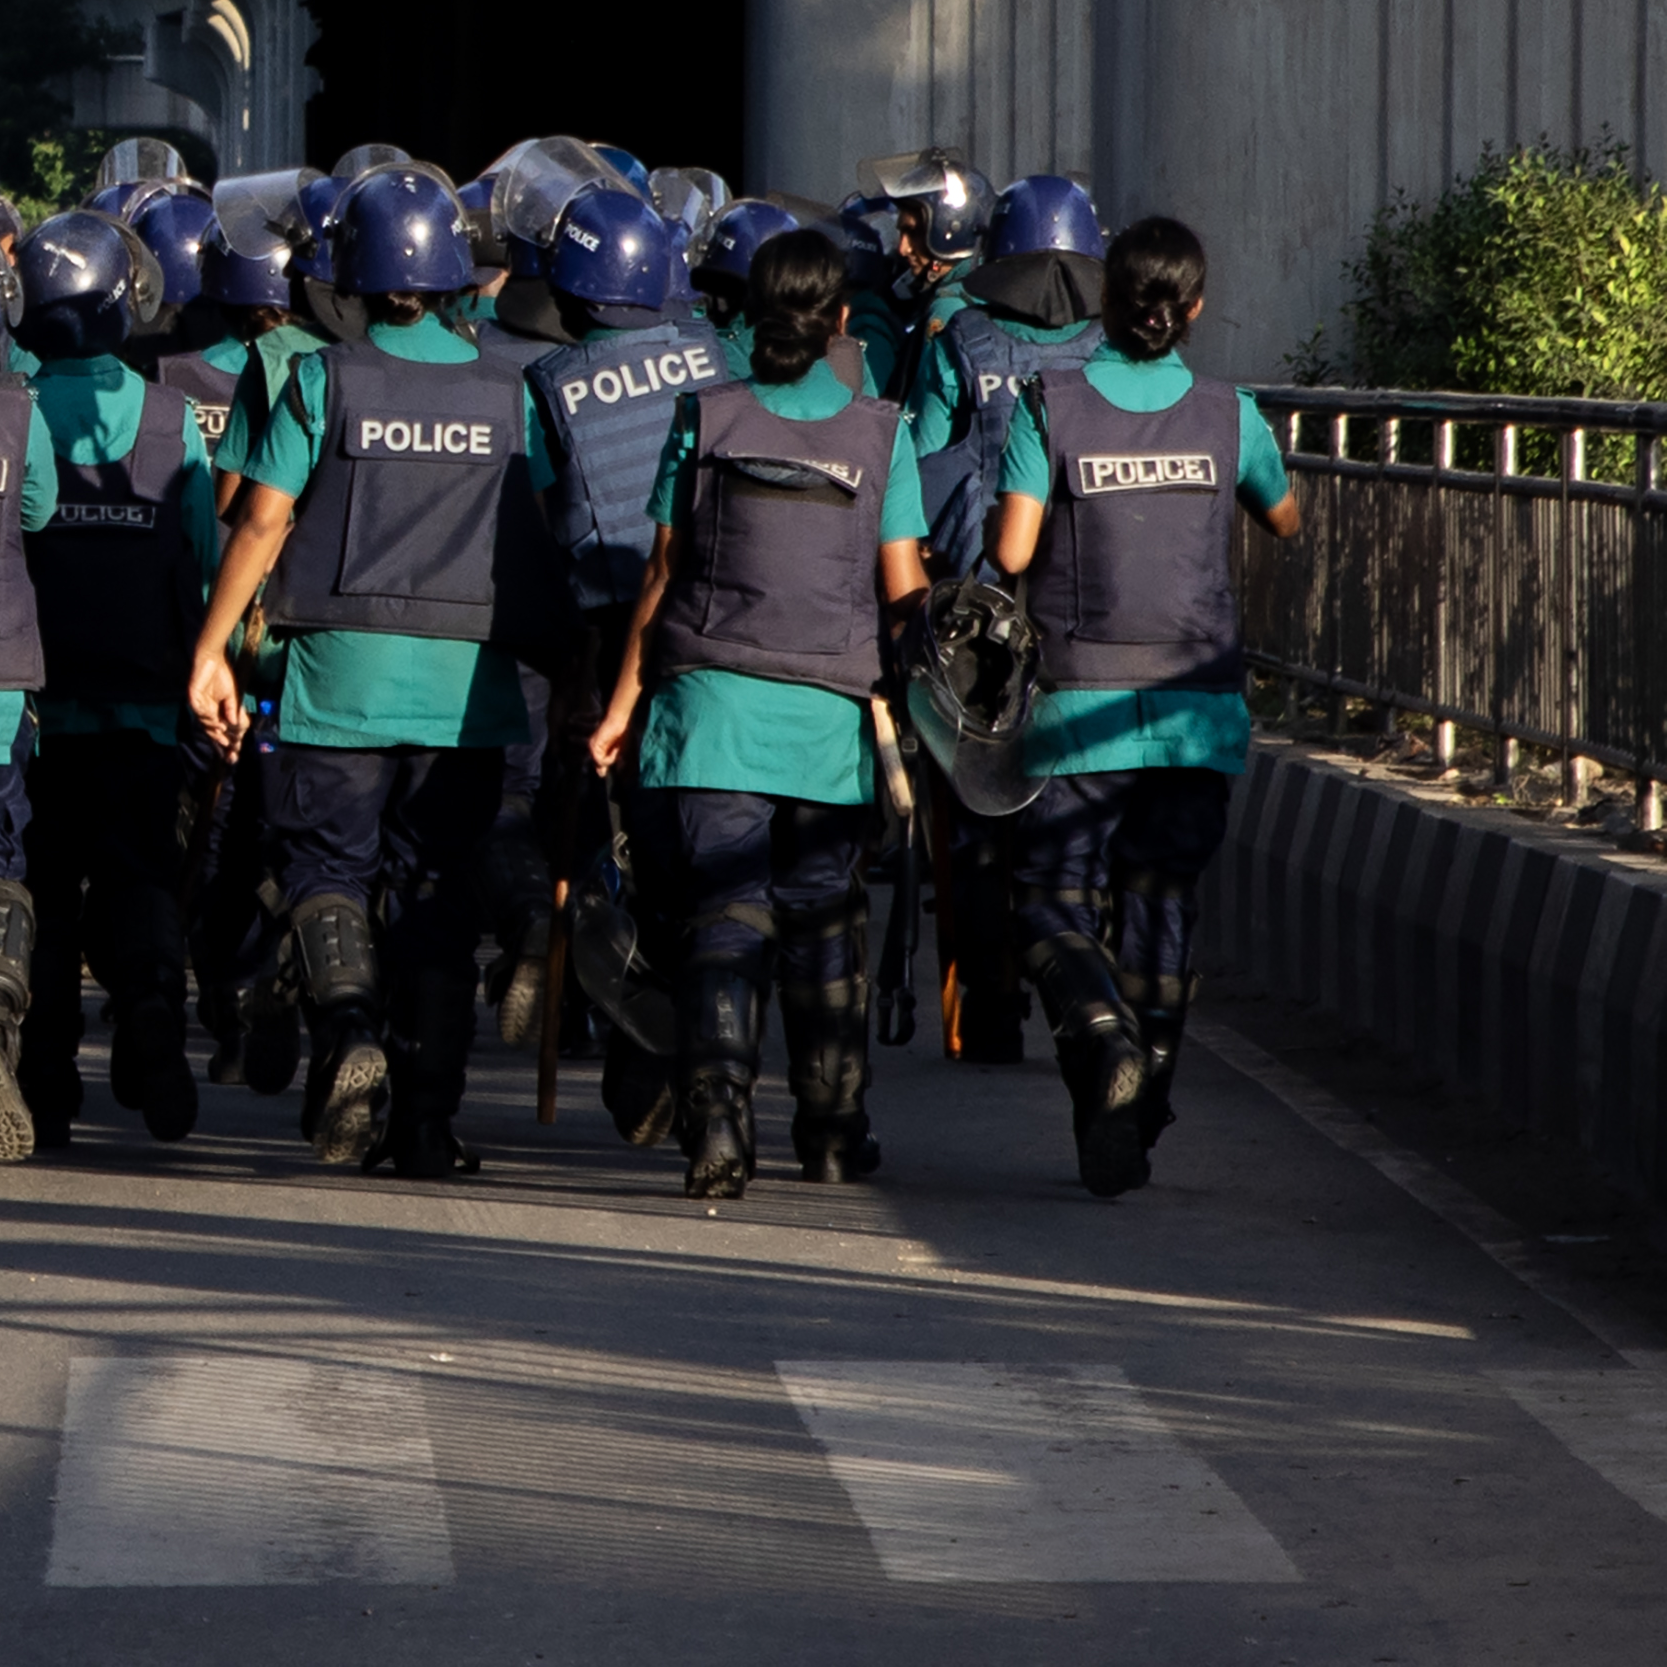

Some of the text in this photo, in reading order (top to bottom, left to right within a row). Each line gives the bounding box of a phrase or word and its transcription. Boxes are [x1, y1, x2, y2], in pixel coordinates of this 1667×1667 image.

[561, 347, 716, 415] POLICE
[361, 420, 492, 455] POLICE
[1092, 458, 1204, 487] POLICE
[60, 504, 143, 523] OLICE
